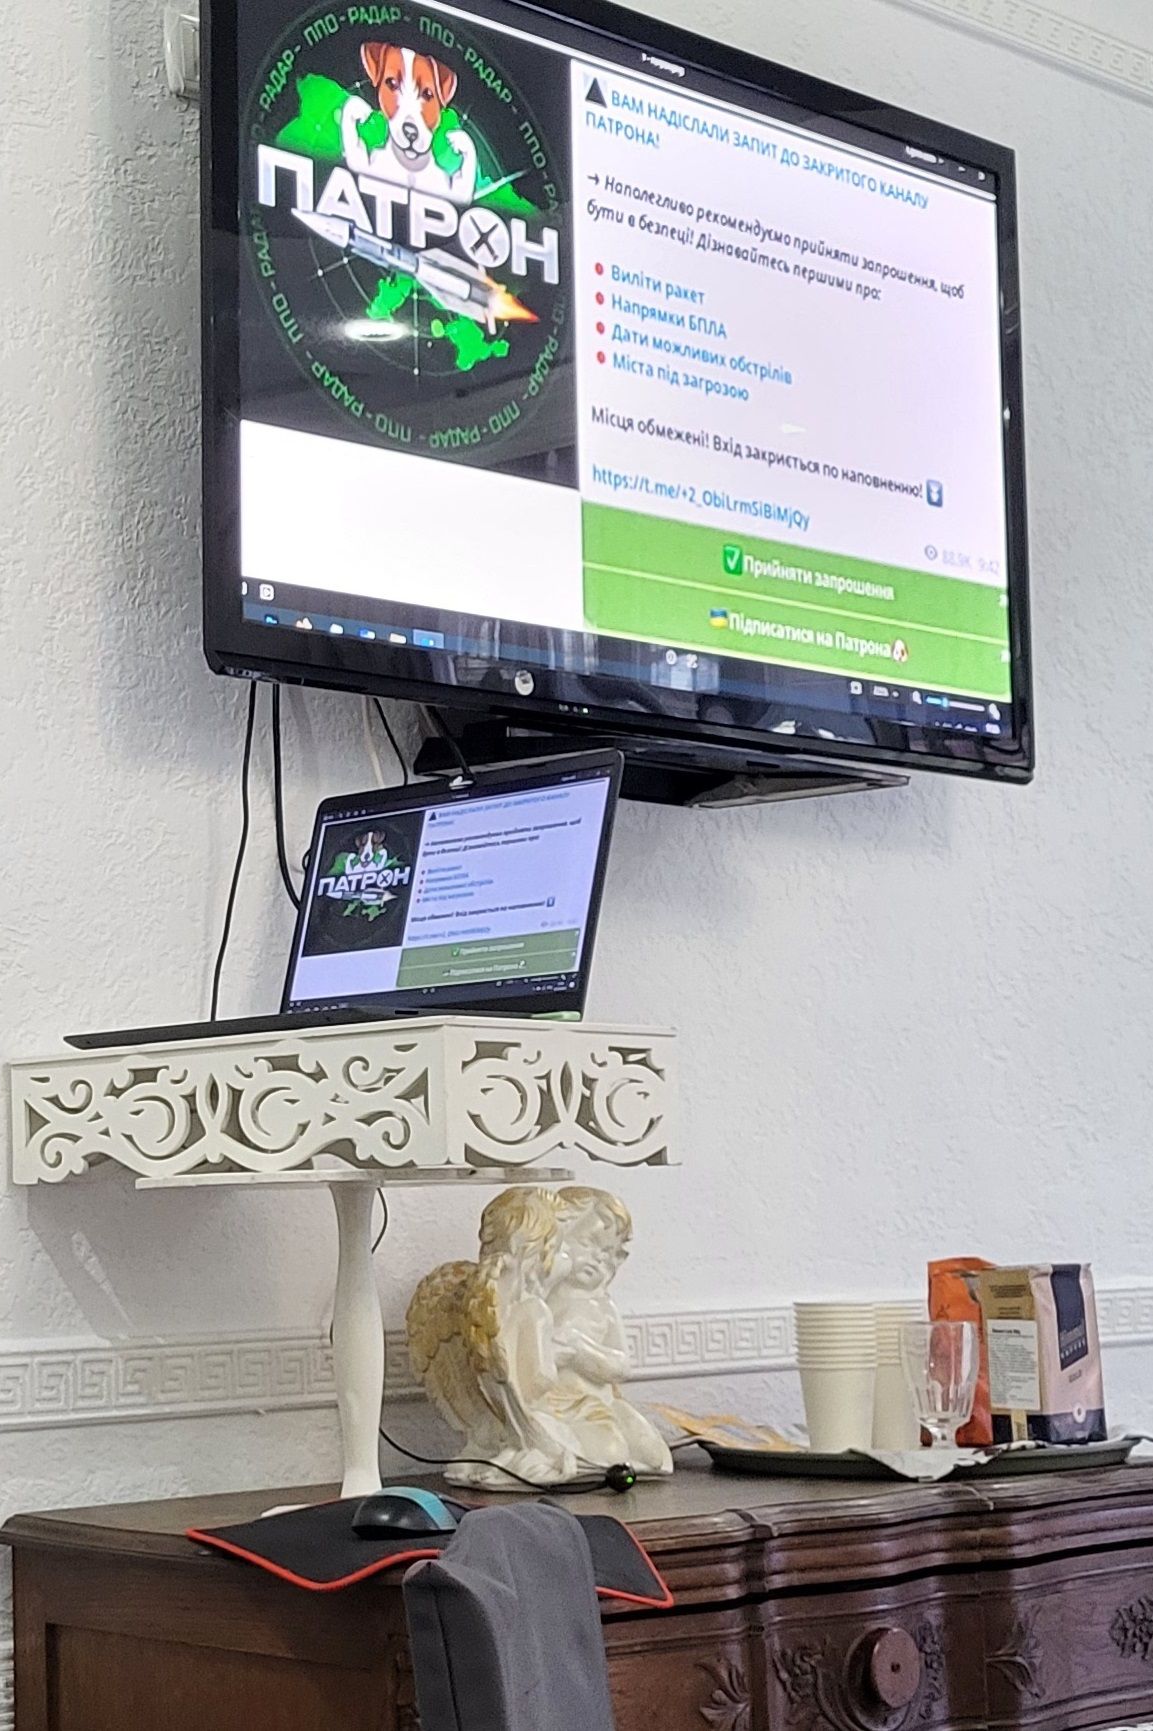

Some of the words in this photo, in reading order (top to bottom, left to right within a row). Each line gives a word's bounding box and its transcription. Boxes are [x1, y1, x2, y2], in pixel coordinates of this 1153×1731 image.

[585, 111, 660, 148] ПАТРОНА!
[611, 90, 643, 114] ВАМ
[648, 103, 729, 143] НАДІСЛАЛИ
[733, 131, 777, 159] ЗАПИТ
[780, 148, 799, 169] ДО
[802, 155, 877, 192] ЗАКРИТОГО
[879, 181, 930, 210] КАНАЛУ
[257, 143, 560, 286] ПАТРОН
[587, 198, 624, 223] бути
[639, 214, 694, 245] безпеці!
[793, 264, 853, 292] першими
[793, 236, 859, 267] прийняти
[940, 281, 965, 300] щоб
[611, 265, 662, 293] Виліти
[665, 282, 705, 305] ракет
[611, 293, 685, 328] Напрямки
[689, 314, 727, 339] БПЛА
[611, 324, 649, 347] Дати
[652, 336, 726, 367] можливих
[730, 355, 793, 385] обстрілів
[613, 352, 654, 378] Міста
[657, 365, 680, 387] під
[683, 373, 749, 401] загрозою
[592, 405, 634, 433] Місця
[637, 418, 709, 449] обмежені!
[713, 435, 743, 459] Вхід
[745, 445, 820, 476] закриється
[822, 463, 839, 479] по
[841, 468, 923, 498] наповненню!
[743, 554, 813, 585] Прийняти
[815, 572, 895, 600] запрошення
[729, 613, 814, 643] Підписатися
[816, 631, 833, 647] на
[835, 631, 891, 658] Патрона
[317, 866, 411, 896] ПАТРОН
